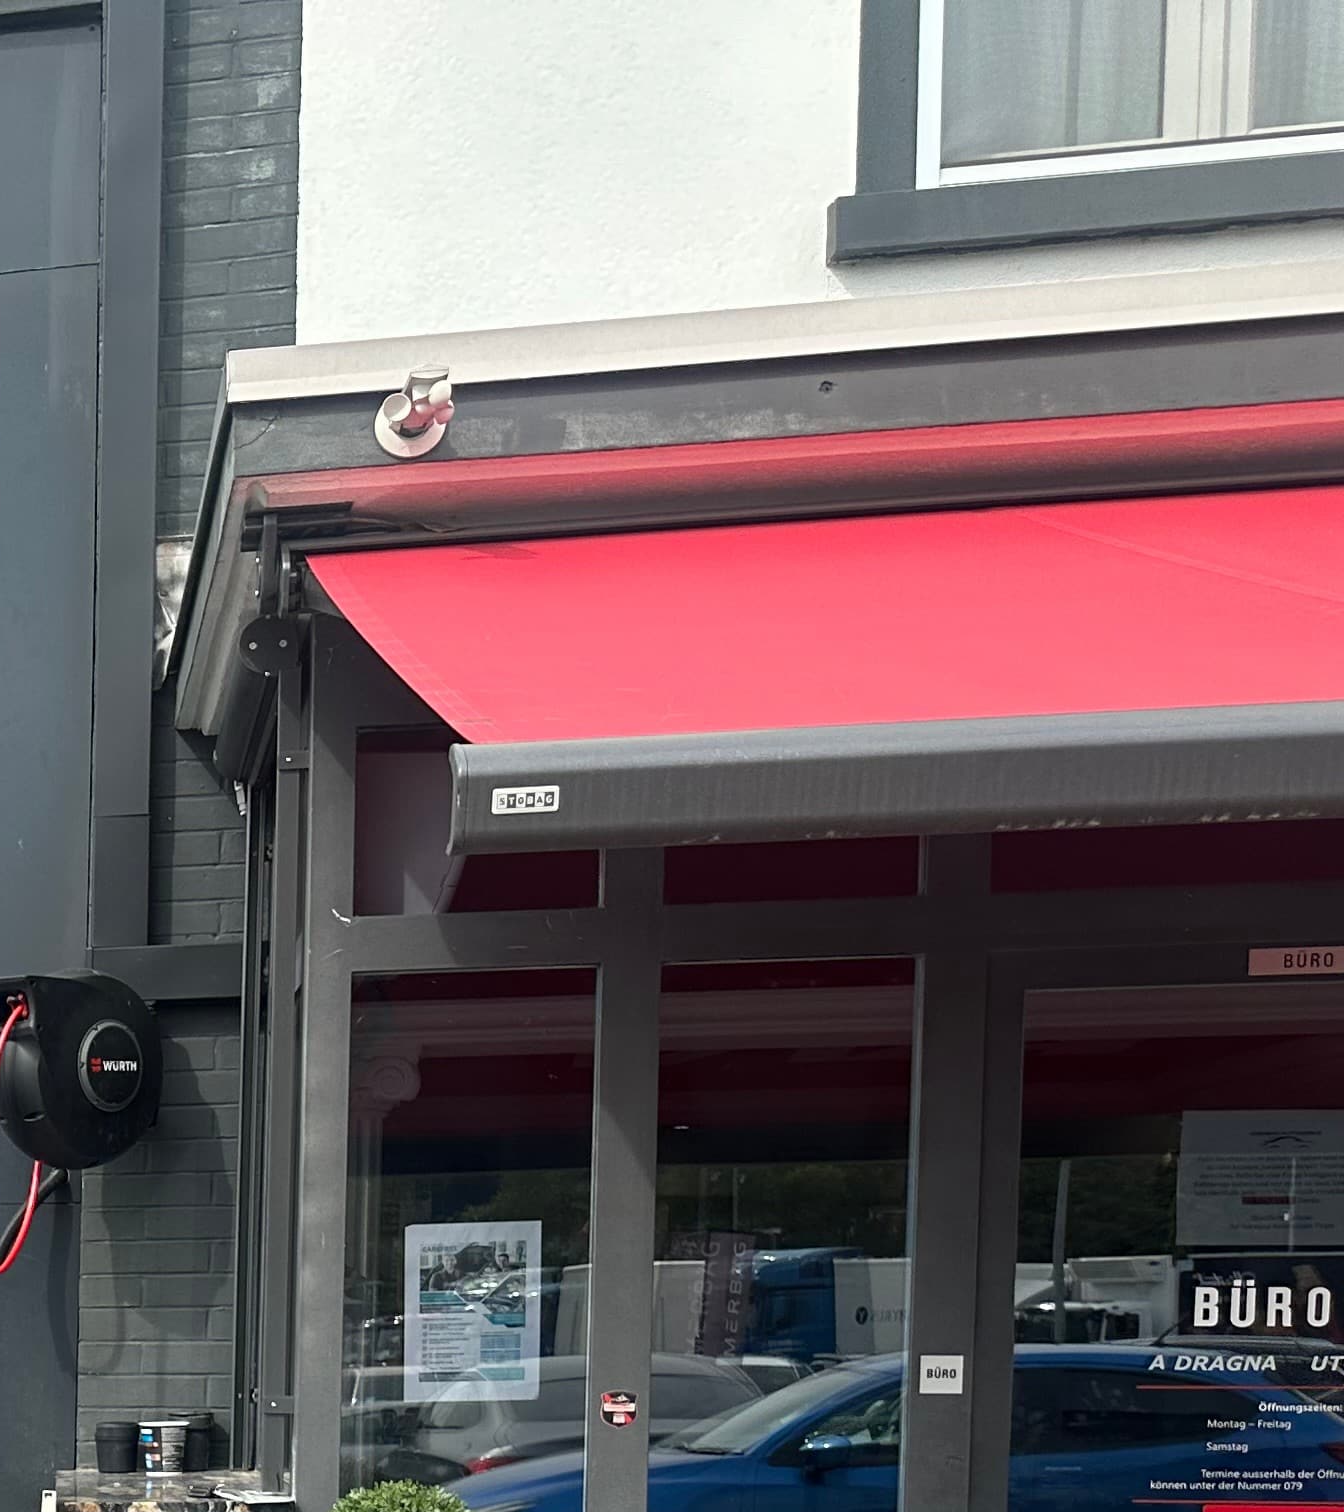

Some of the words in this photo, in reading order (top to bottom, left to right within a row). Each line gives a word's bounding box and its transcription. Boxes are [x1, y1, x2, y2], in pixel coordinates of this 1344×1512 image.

[498, 793, 555, 807] STOBAG
[1283, 950, 1334, 968] BÜRO
[102, 1060, 137, 1072] WÜRTH
[1193, 1279, 1332, 1328] BÜRO
[926, 1366, 957, 1380] BÜRO
[1207, 1419, 1246, 1431] Montag
[1257, 1419, 1292, 1431] Freitag
[1206, 1442, 1249, 1453] Samstag
[1201, 1469, 1241, 1479] Termine
[1242, 1468, 1296, 1479] ausserhalb
[1298, 1469, 1315, 1479] der
[1150, 1480, 1187, 1490] können
[1189, 1481, 1215, 1490] unter
[1218, 1480, 1234, 1490] der
[1237, 1481, 1281, 1490] Nummer
[1283, 1481, 1303, 1490] 079
